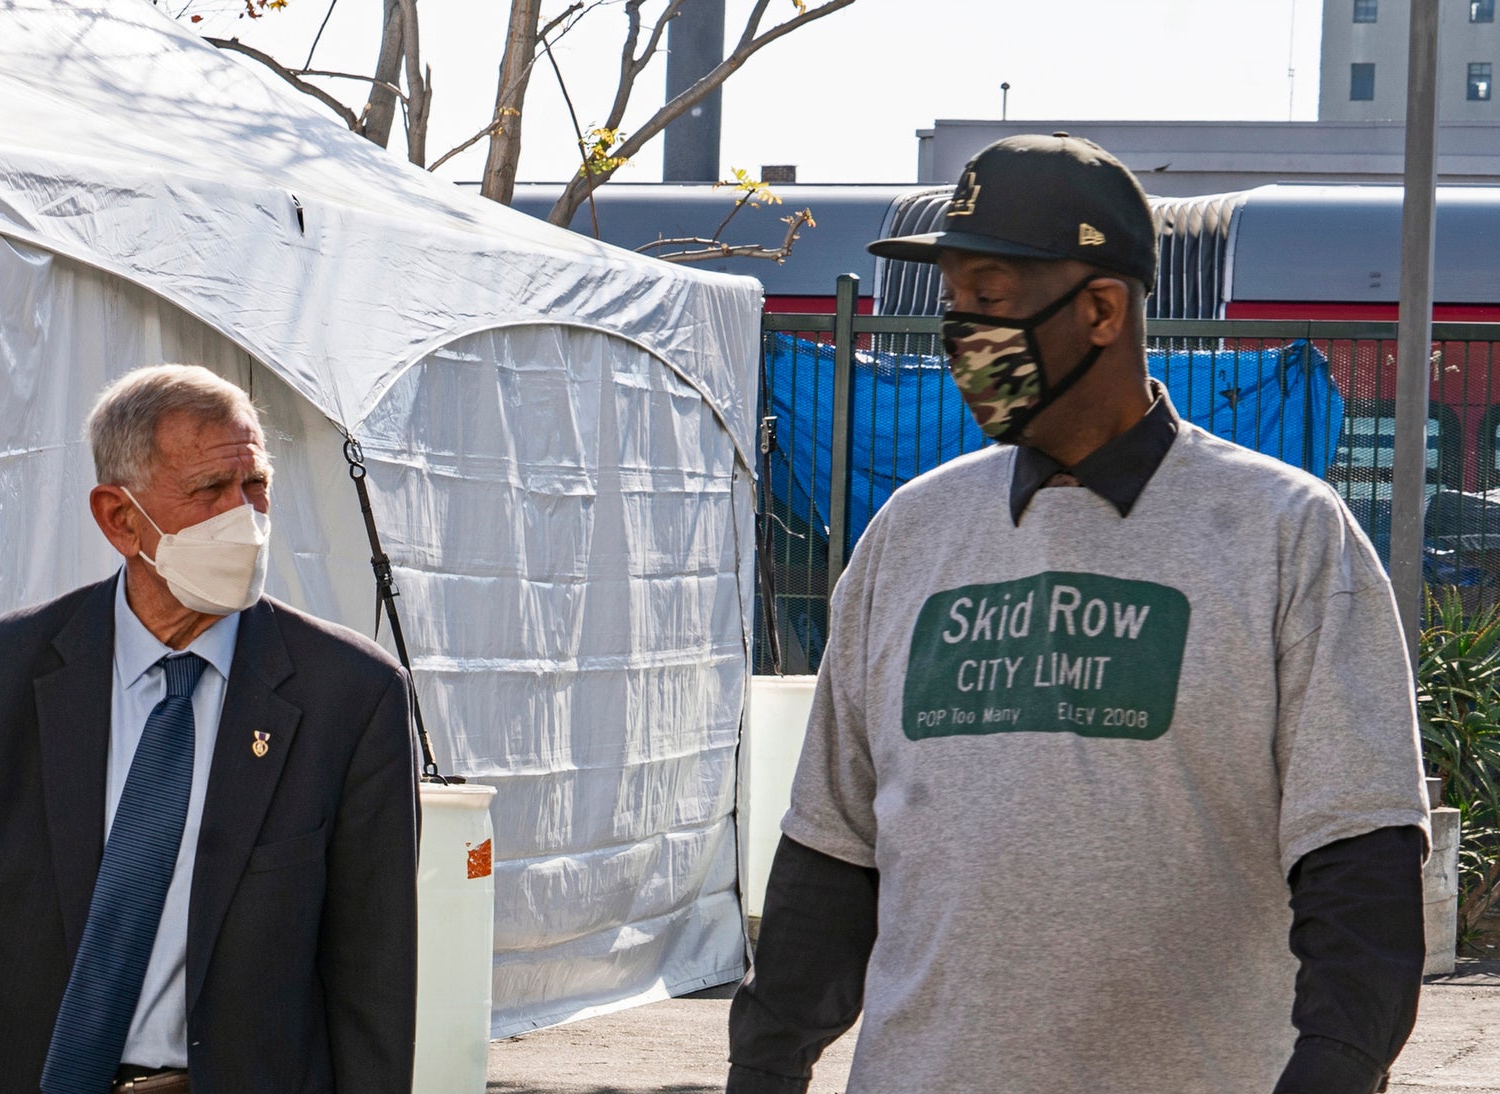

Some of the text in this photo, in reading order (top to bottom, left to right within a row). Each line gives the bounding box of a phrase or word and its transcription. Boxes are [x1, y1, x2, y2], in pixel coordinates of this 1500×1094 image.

[942, 585, 1151, 644] Skid Row
[957, 652, 1112, 692] CITY LIMIT
[917, 702, 1149, 729] POP Too Many ELEV 2008
